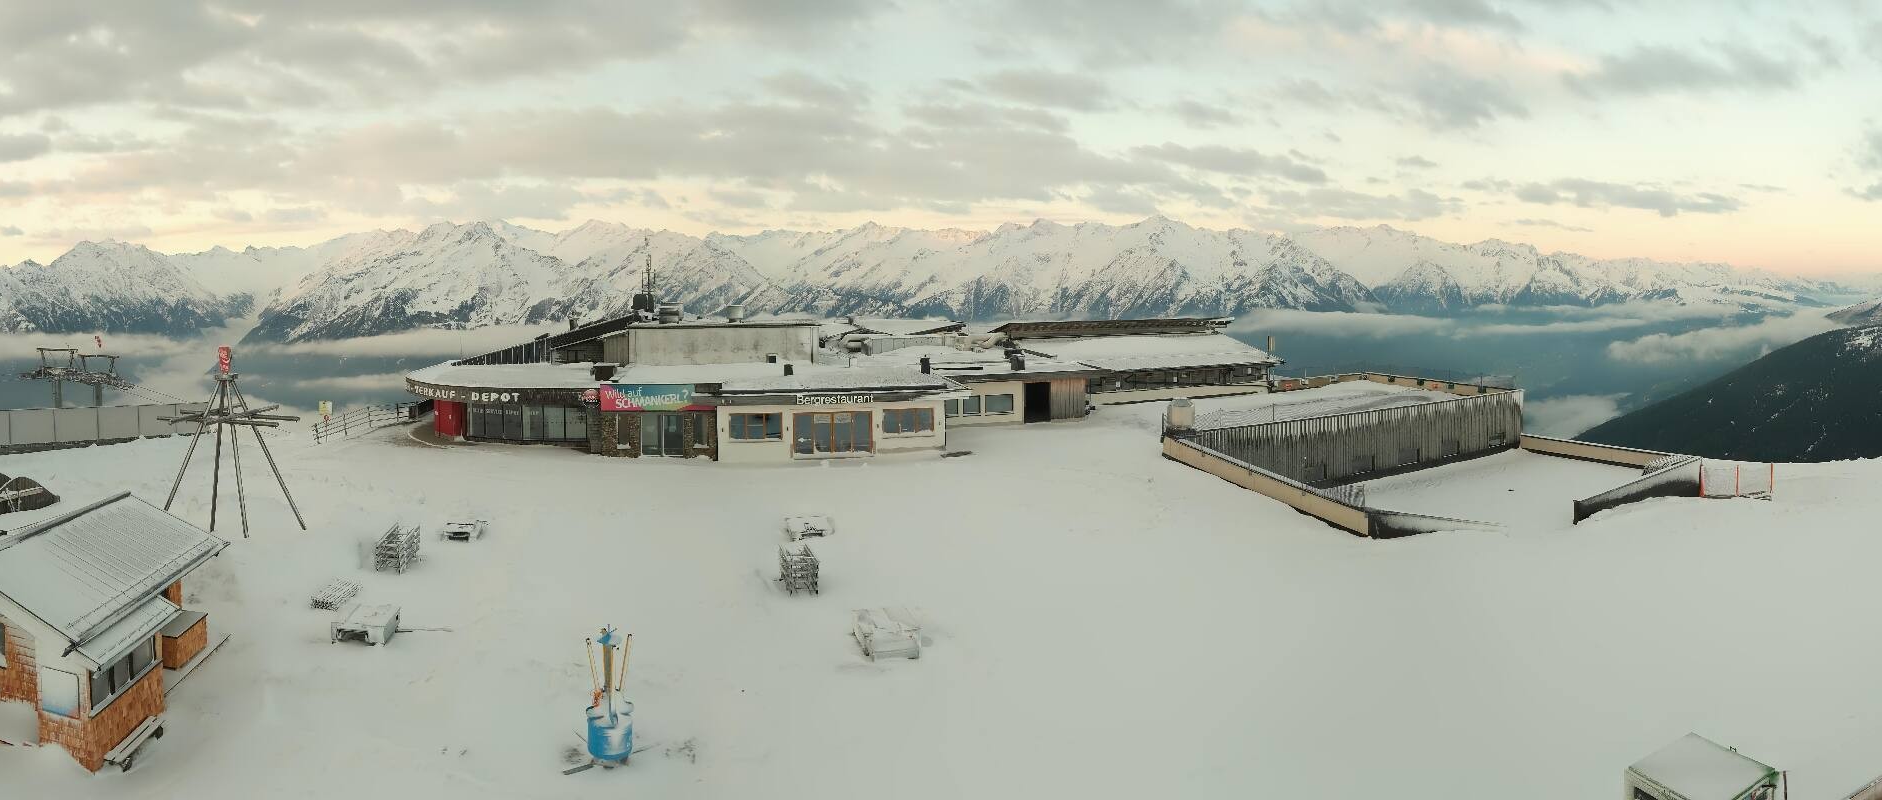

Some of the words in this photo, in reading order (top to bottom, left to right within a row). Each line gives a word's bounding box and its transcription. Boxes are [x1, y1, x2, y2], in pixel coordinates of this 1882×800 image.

[471, 391, 521, 402] DEPOT
[605, 388, 625, 400] Wild
[627, 386, 643, 397] auf
[796, 393, 874, 406] Bergrestaurant
